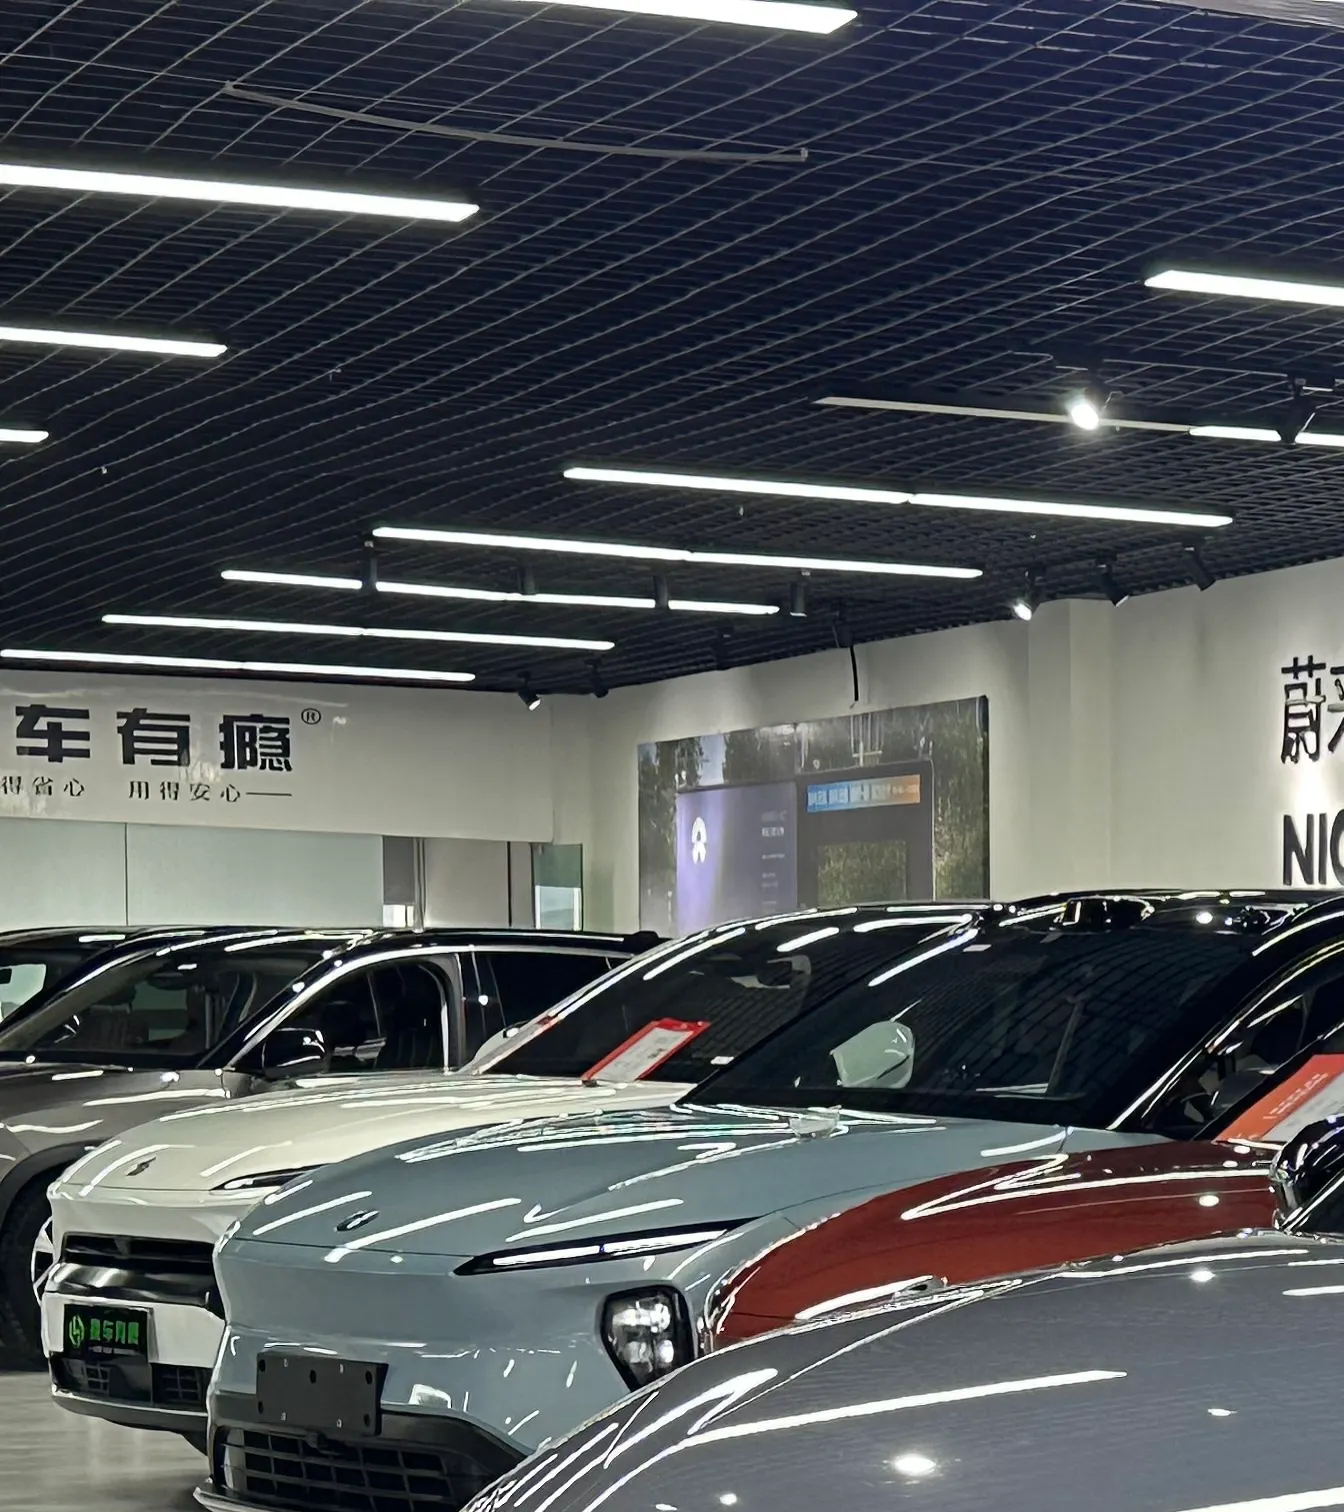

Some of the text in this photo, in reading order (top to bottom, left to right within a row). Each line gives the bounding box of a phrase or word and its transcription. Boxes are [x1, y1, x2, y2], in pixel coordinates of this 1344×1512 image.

[15, 704, 293, 772] 车有瘾
[128, 780, 241, 803] 用得安心
